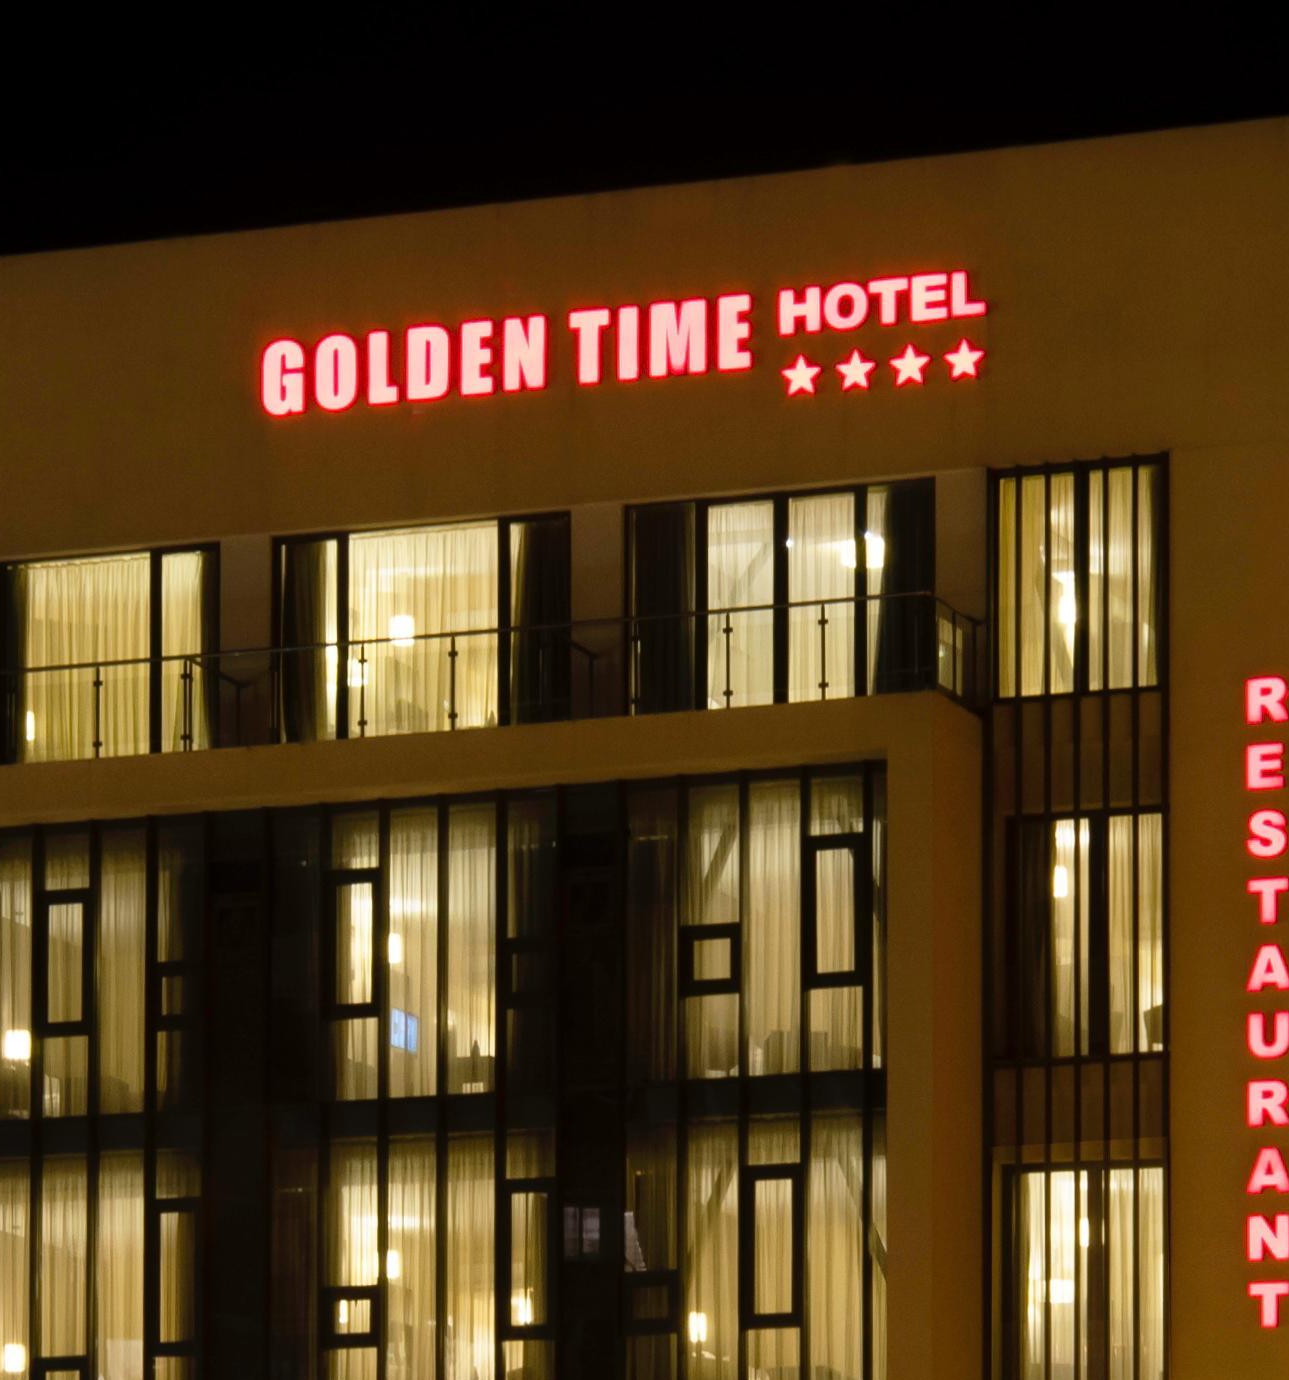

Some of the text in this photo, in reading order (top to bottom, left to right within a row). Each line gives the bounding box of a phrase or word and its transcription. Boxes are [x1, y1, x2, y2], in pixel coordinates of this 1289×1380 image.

[778, 271, 986, 337] HOTEL
[261, 292, 752, 418] GOLDEN TIME
